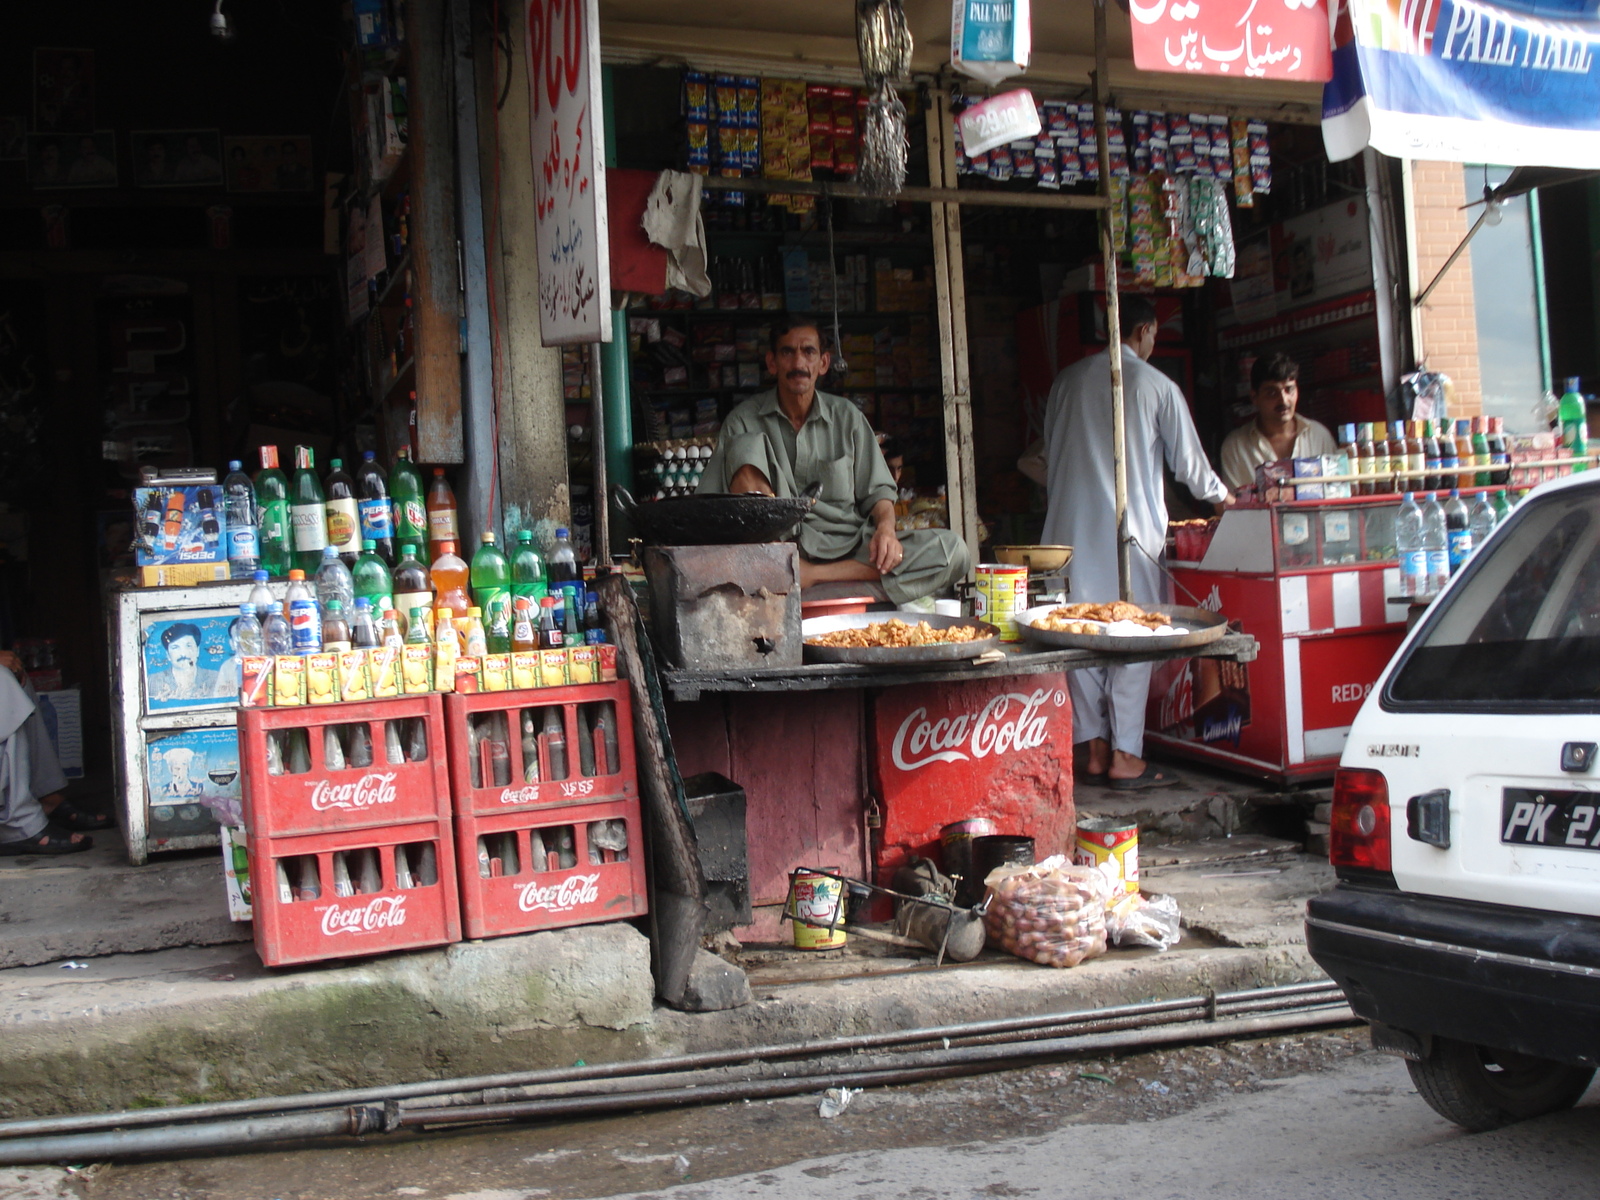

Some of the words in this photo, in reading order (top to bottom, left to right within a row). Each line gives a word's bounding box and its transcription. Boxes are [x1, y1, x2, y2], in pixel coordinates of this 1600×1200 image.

[970, 2, 990, 22] PALL
[992, 2, 1012, 22] MALL
[1164, 27, 1203, 71] ہیں
[1202, 20, 1302, 77] دستیاب
[1441, 2, 1518, 66] PALL
[1520, 29, 1593, 74] MALL
[976, 107, 1019, 138] 29.10
[362, 504, 391, 516] PEPSI
[180, 551, 215, 560] PEPSI
[892, 688, 1053, 771] Coca-Cola
[311, 772, 397, 811] Coca-Cola
[500, 785, 540, 804] Coca-Cola
[1503, 801, 1557, 843] PK
[518, 872, 601, 912] Coca-Cola
[321, 895, 407, 936] Coca-Cola
